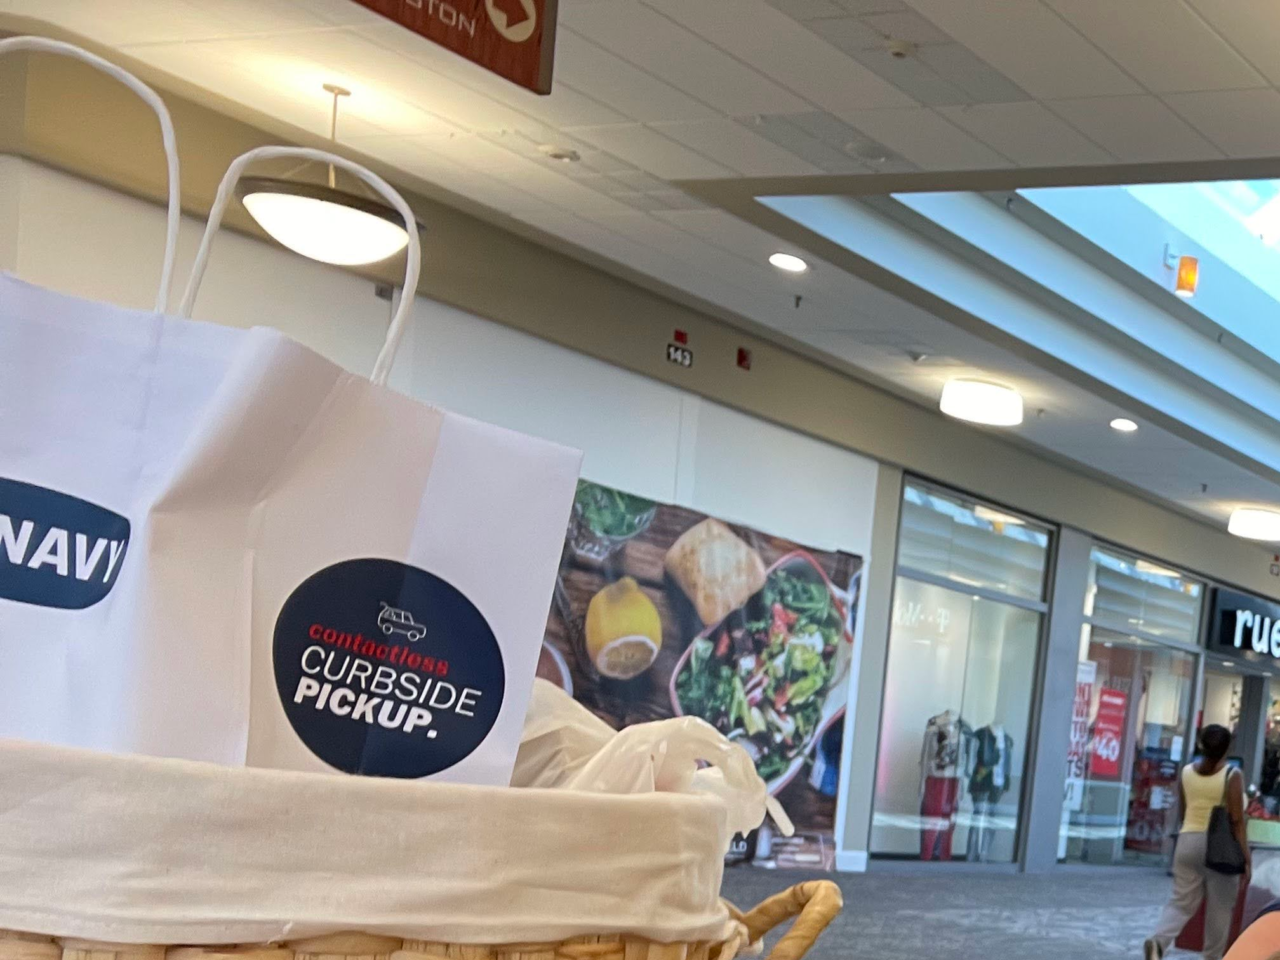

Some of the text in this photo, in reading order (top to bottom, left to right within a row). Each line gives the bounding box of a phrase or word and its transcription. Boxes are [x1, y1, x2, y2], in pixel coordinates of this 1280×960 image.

[0, 513, 125, 584] NAVY
[301, 645, 482, 717] CURBSIDE
[308, 623, 450, 677] contactless
[293, 675, 438, 739] PICKUP.
